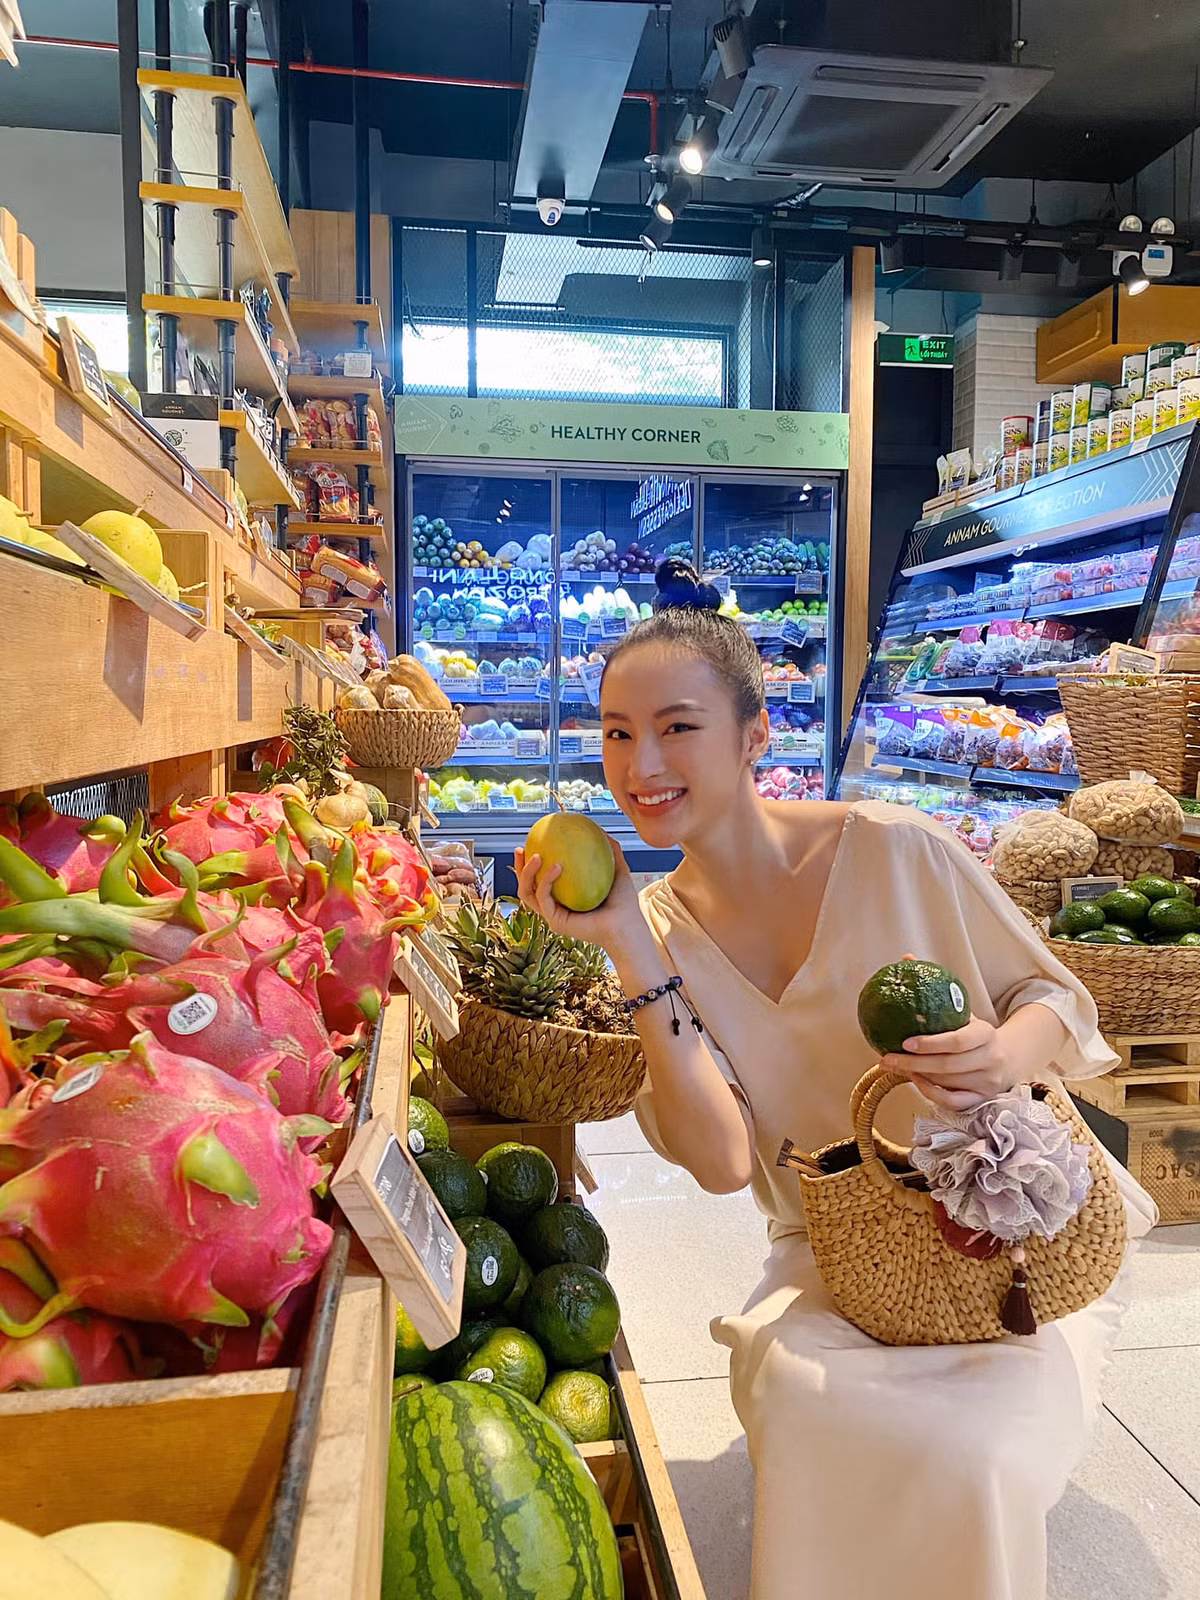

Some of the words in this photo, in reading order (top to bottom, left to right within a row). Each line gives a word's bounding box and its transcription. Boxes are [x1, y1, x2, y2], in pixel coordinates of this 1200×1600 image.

[922, 340, 946, 350] EXIT
[551, 425, 627, 441] HEALTHY
[631, 428, 701, 444] CORNER
[943, 522, 981, 548] ANNAM
[980, 507, 1033, 536] GOURMET
[1034, 481, 1107, 518] SELECTION
